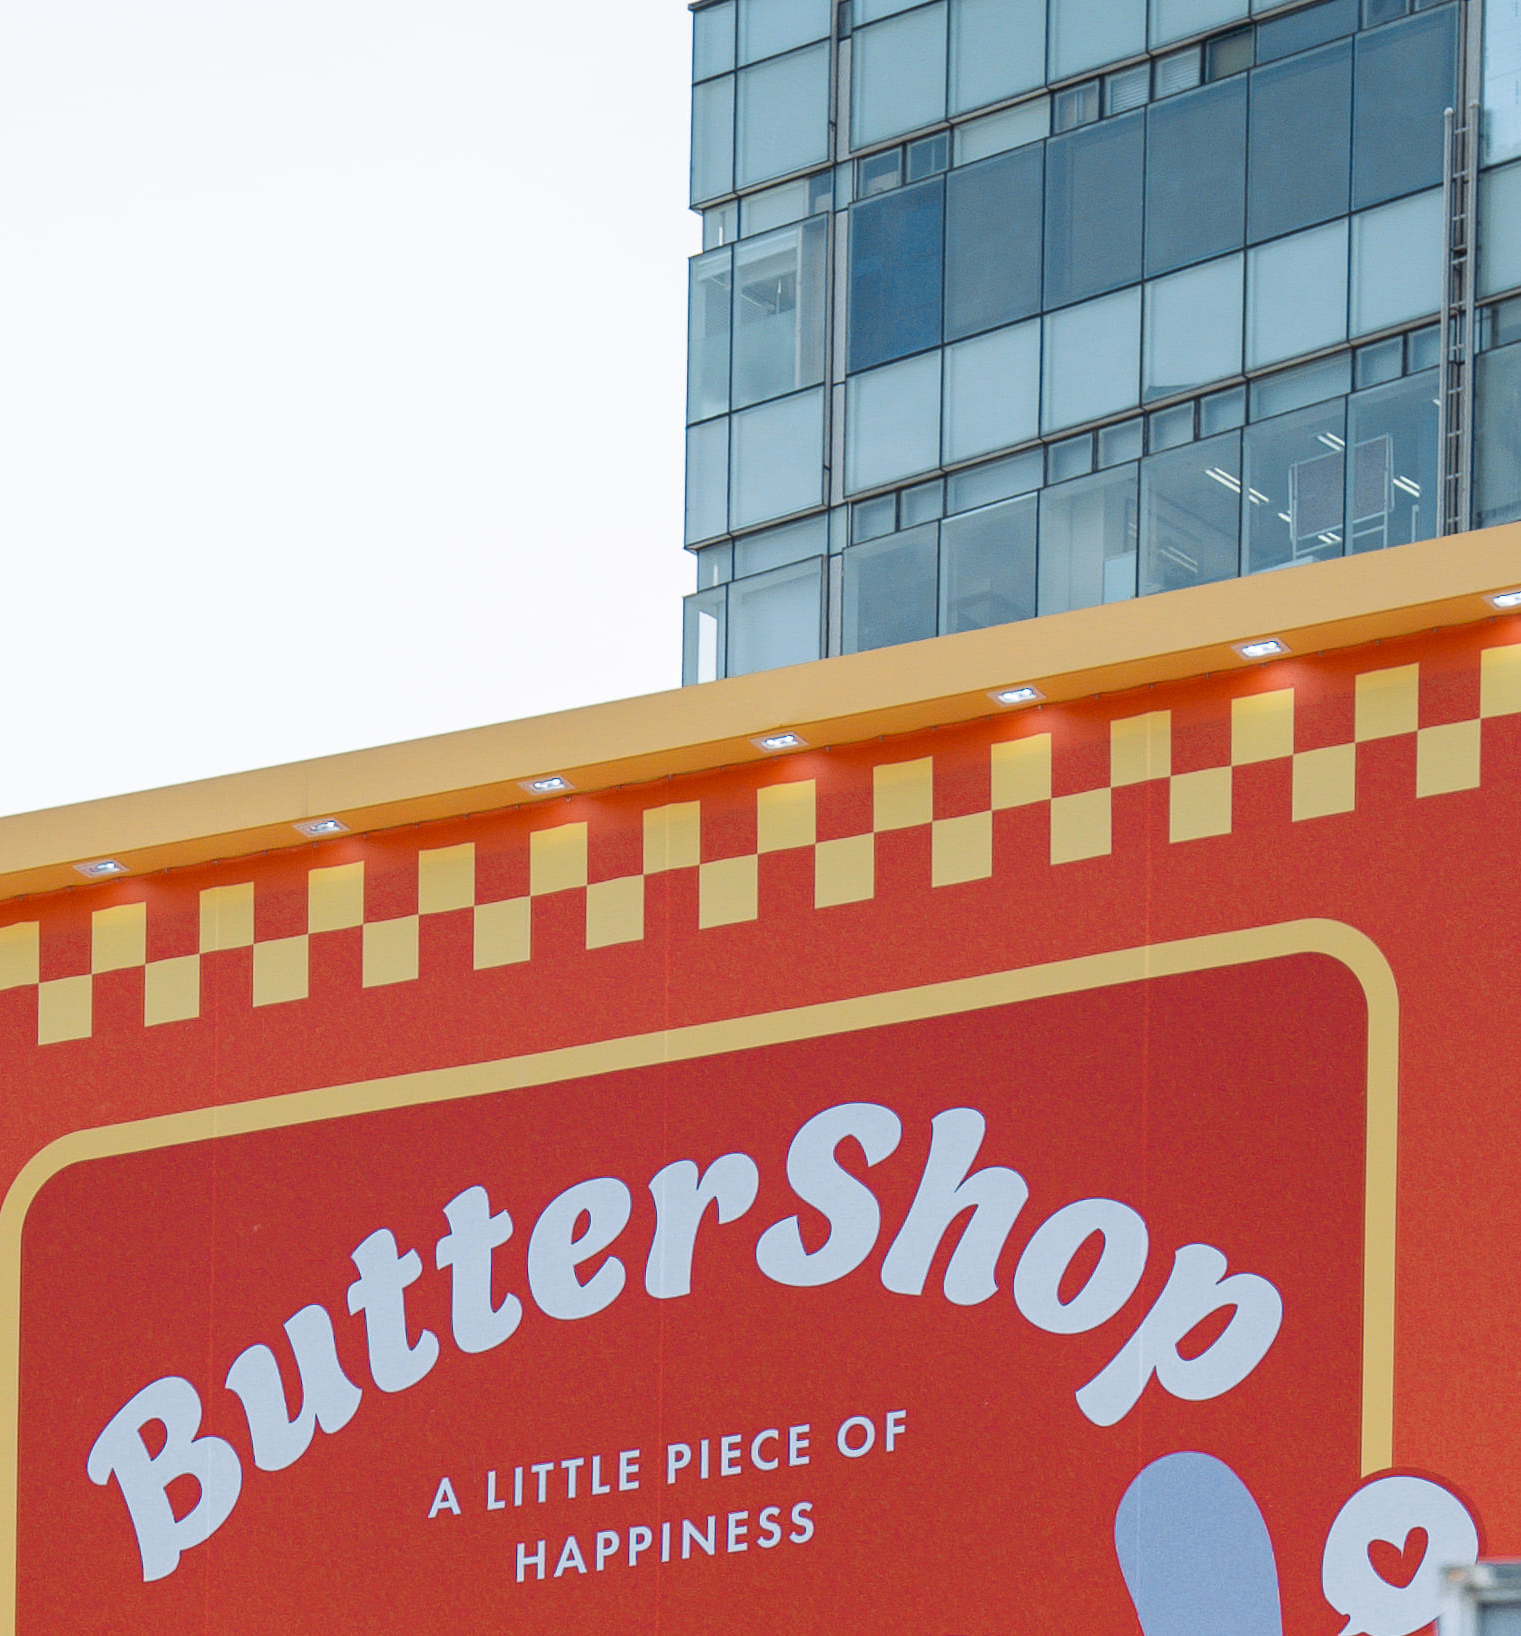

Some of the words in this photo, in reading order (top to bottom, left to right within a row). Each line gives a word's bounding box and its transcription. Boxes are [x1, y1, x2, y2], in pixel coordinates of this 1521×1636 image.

[86, 1102, 1282, 1583] ButterShop
[428, 1477, 462, 1518] A
[486, 1449, 640, 1510] LITTLE
[666, 1424, 811, 1484] PIECE
[836, 1409, 907, 1458] OF
[515, 1502, 816, 1582] HAPPINESS
